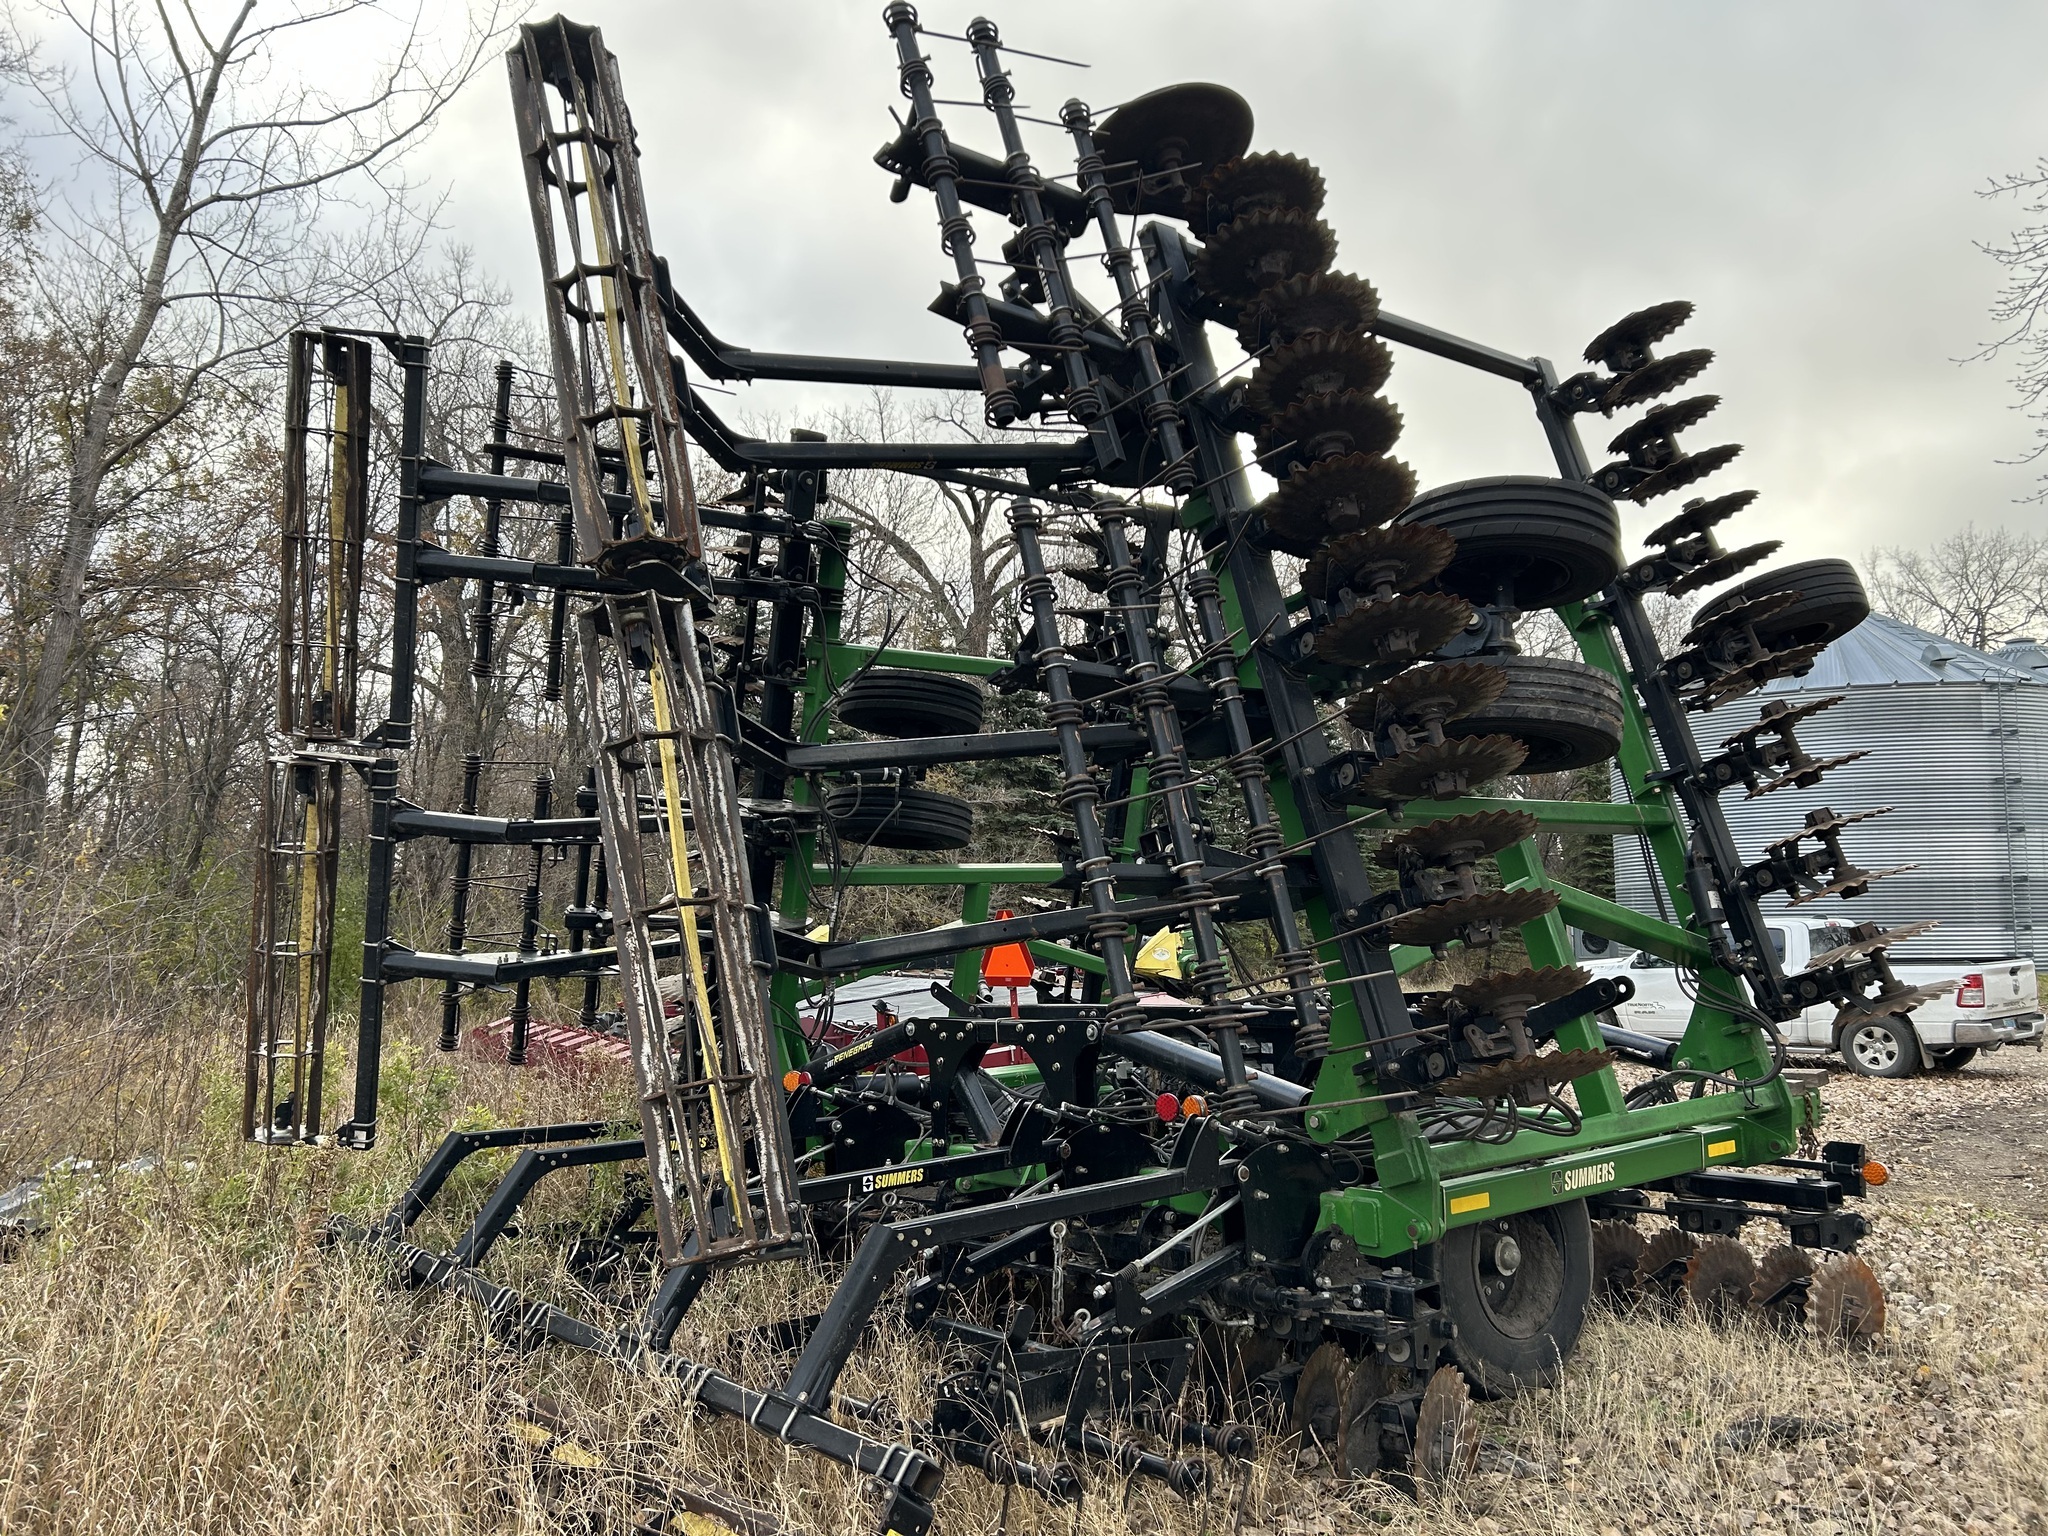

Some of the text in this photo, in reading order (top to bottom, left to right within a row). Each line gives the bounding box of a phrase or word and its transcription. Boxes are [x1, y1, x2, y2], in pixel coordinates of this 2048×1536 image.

[834, 1039, 874, 1063] RENEGADE
[874, 1168, 924, 1189] SUMMERS
[1564, 1161, 1615, 1191] SUMMERS
